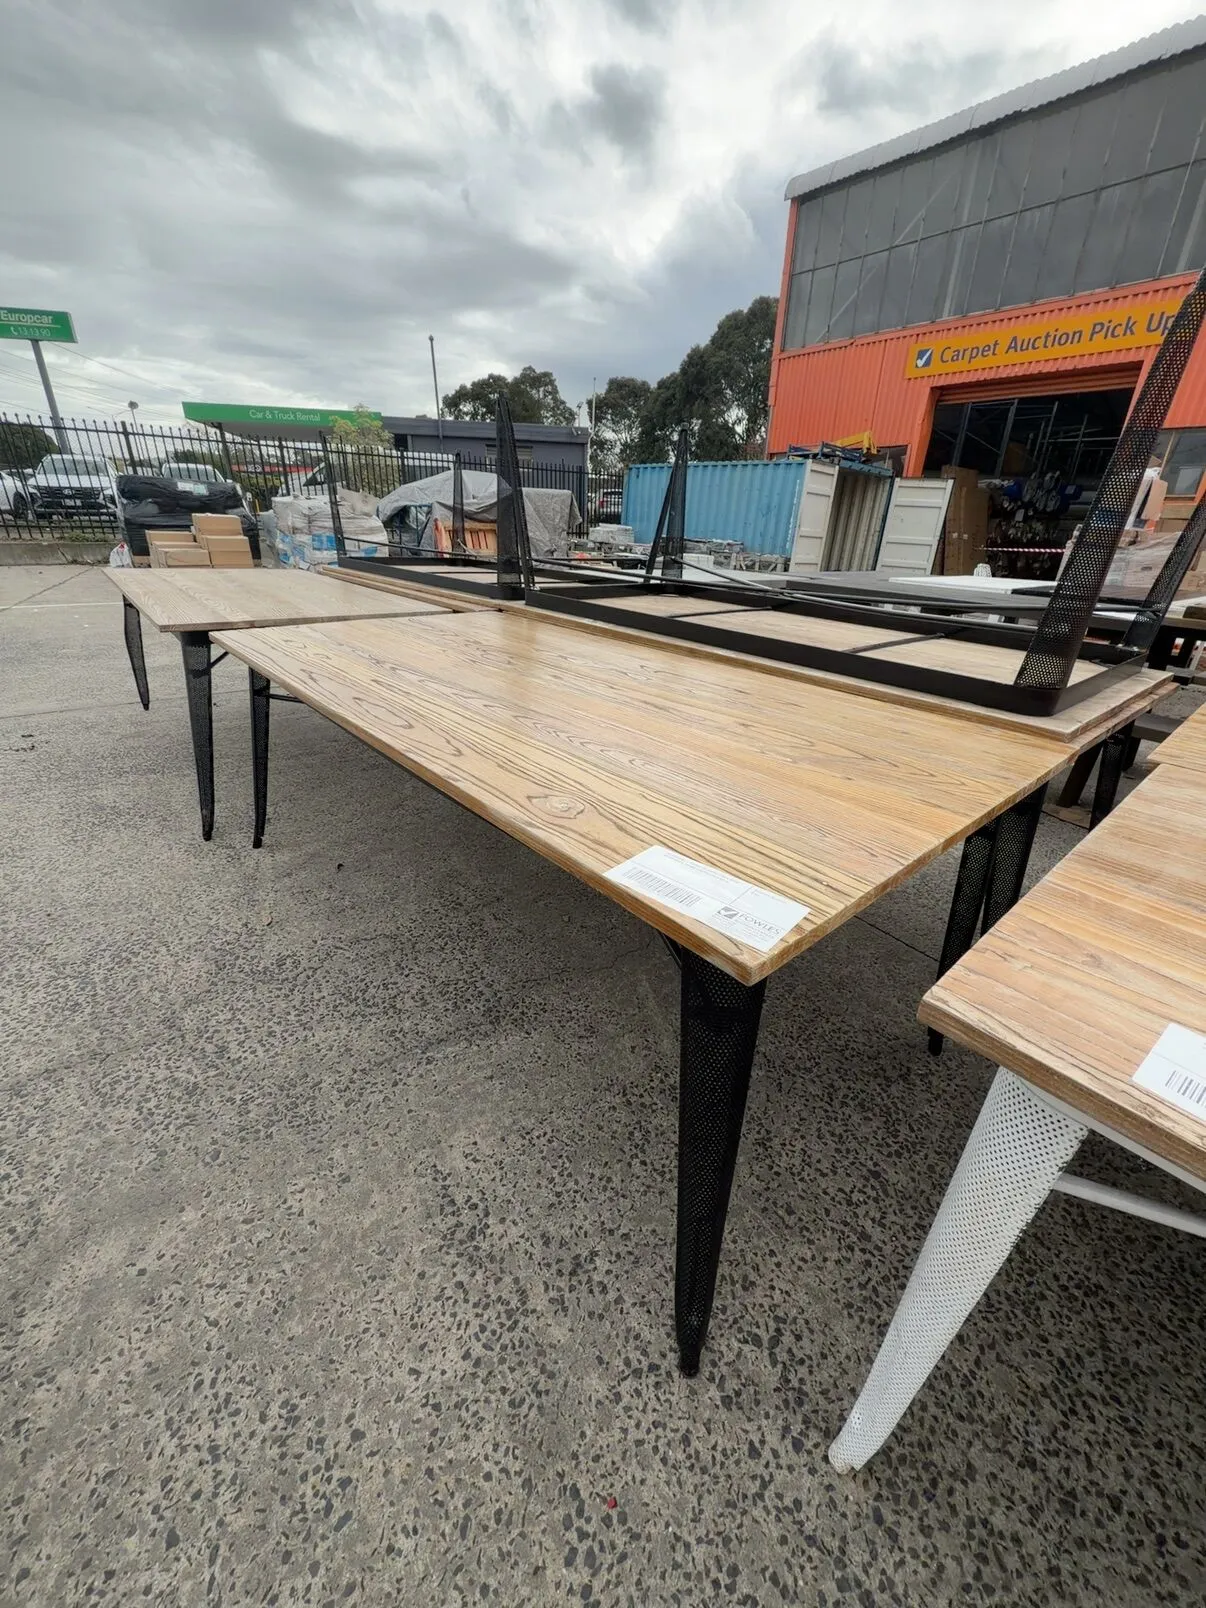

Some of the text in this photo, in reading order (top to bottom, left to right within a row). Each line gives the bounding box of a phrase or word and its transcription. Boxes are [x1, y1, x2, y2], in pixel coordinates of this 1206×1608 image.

[0, 310, 53, 324] Europcar
[940, 339, 999, 364] Carpet
[1005, 328, 1083, 354] Auction
[1089, 315, 1138, 342] Pick
[249, 409, 321, 422] Car & Truck Rental
